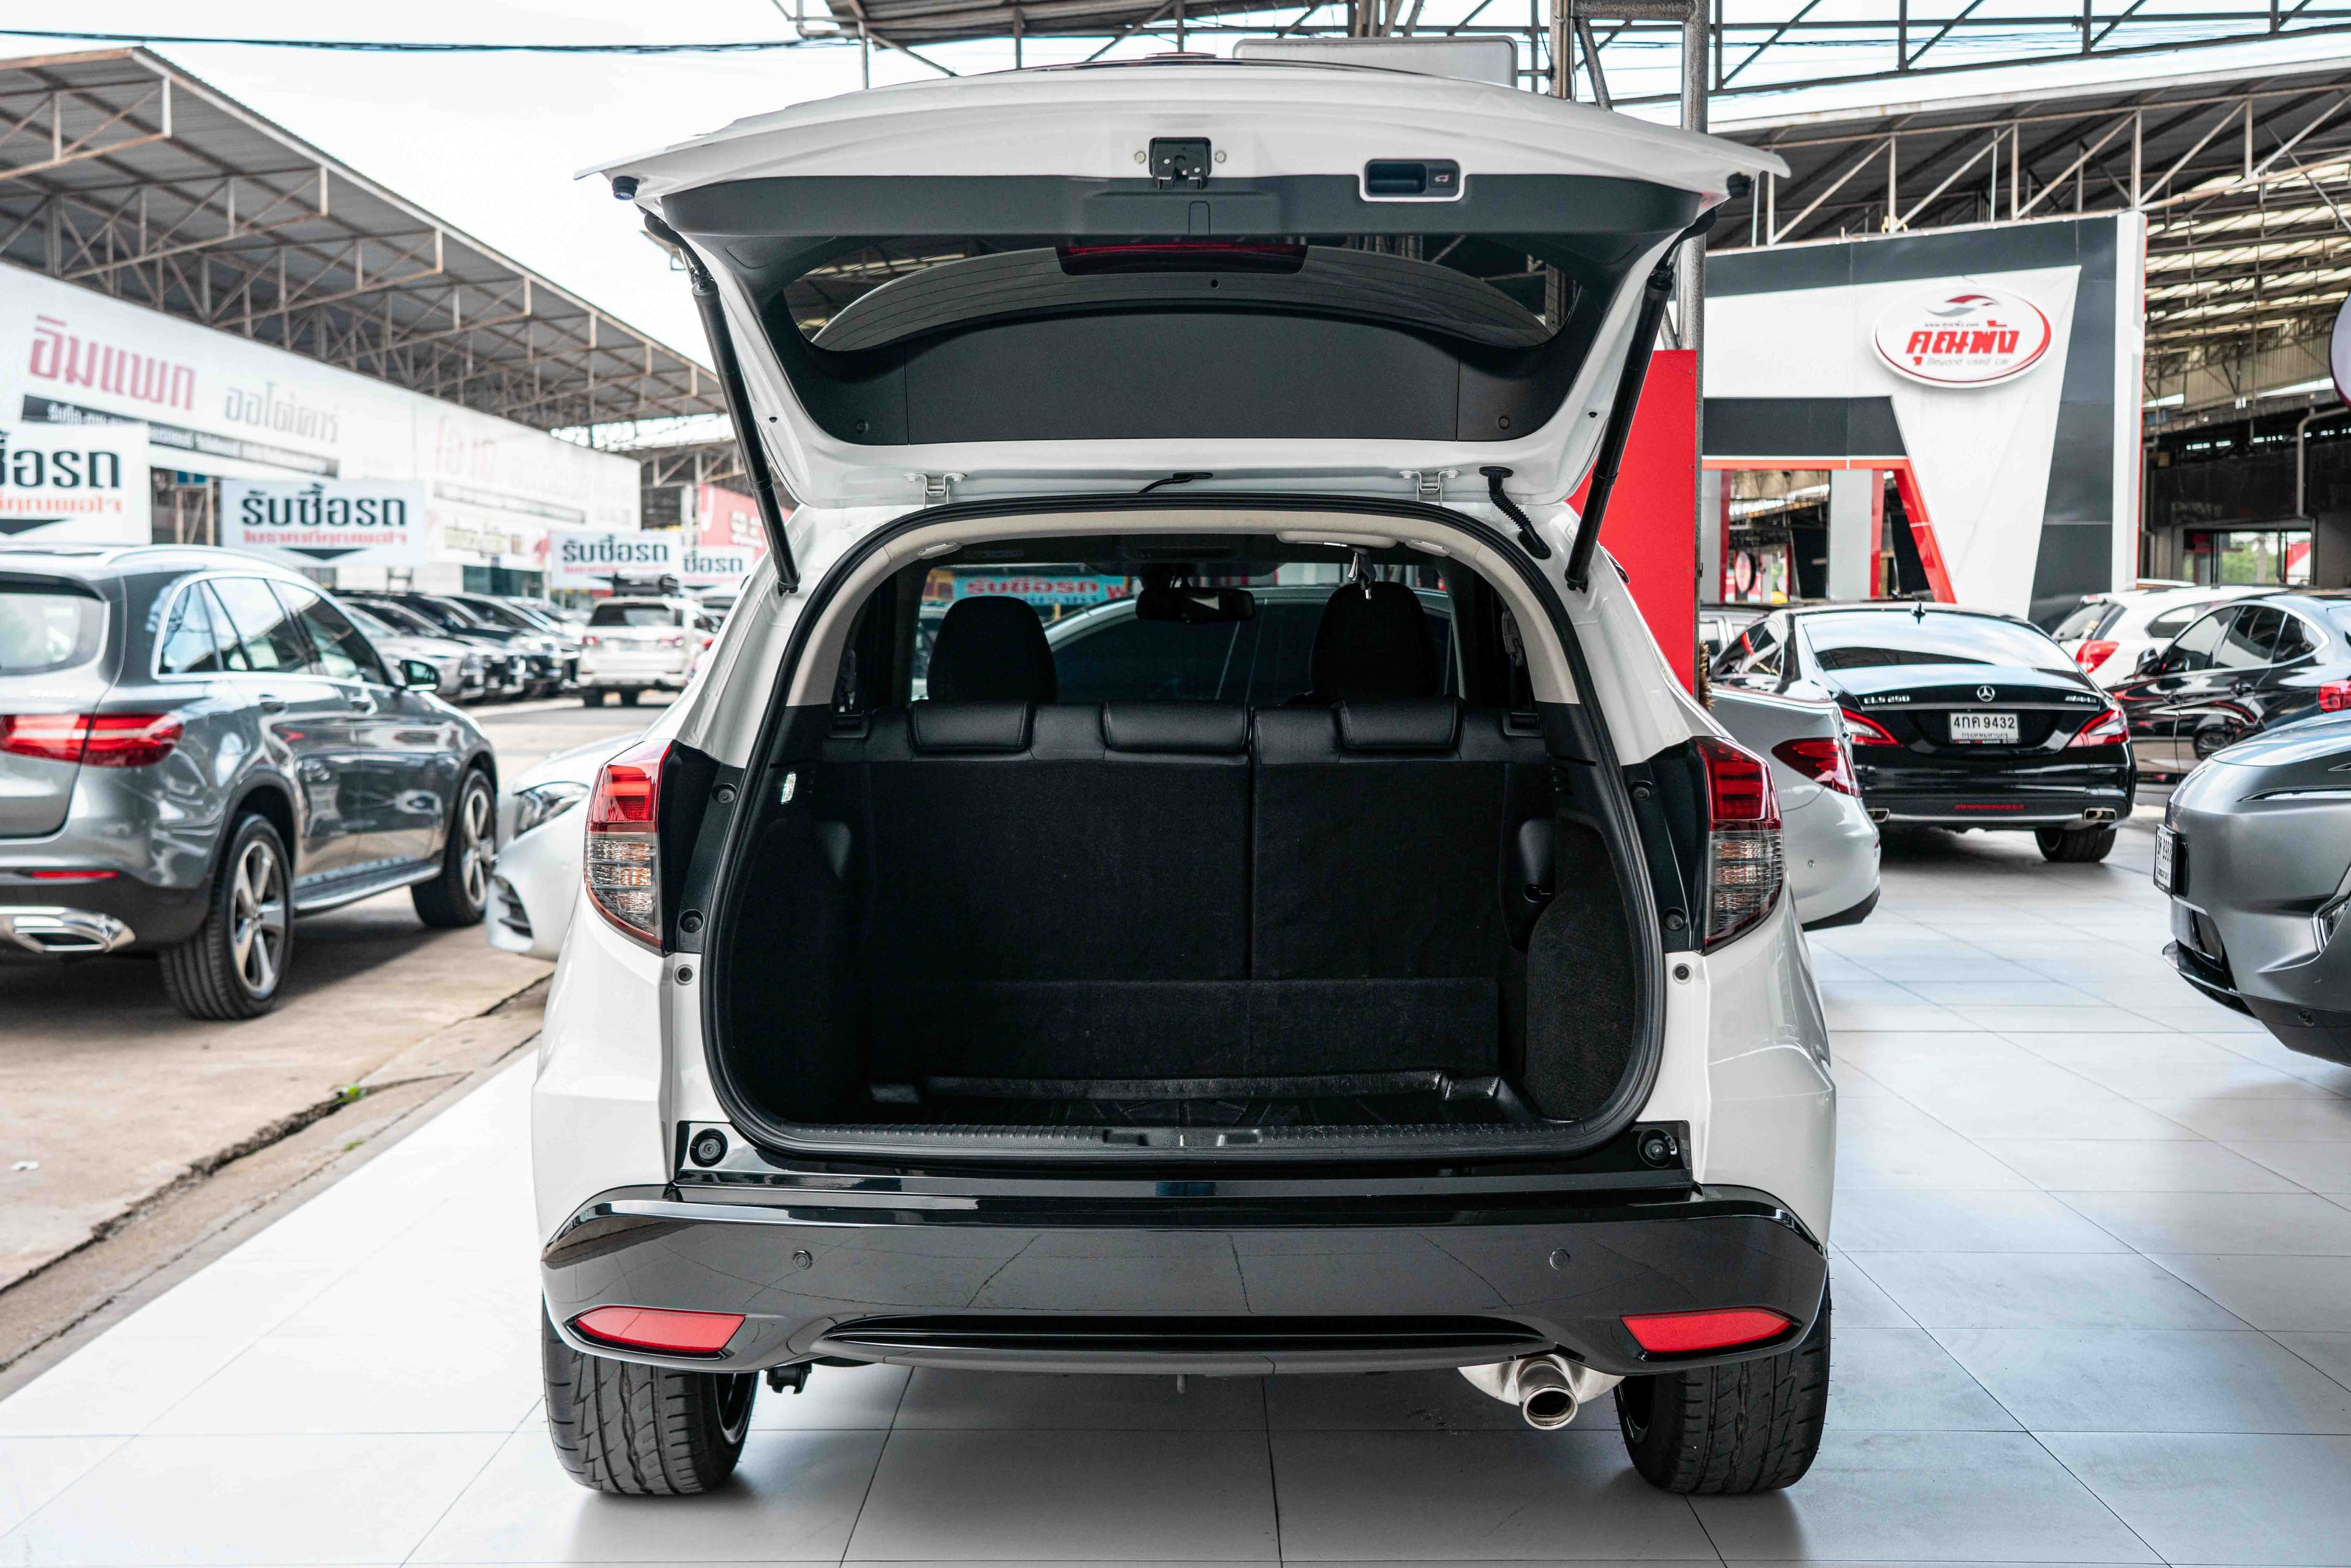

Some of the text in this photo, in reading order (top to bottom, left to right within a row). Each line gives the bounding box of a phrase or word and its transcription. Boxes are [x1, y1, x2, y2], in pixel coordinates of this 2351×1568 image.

[242, 482, 407, 526] รับซื้อรถ
[563, 533, 669, 562] รับซื้อรถ
[1954, 716, 2015, 729] 4กค 9432
